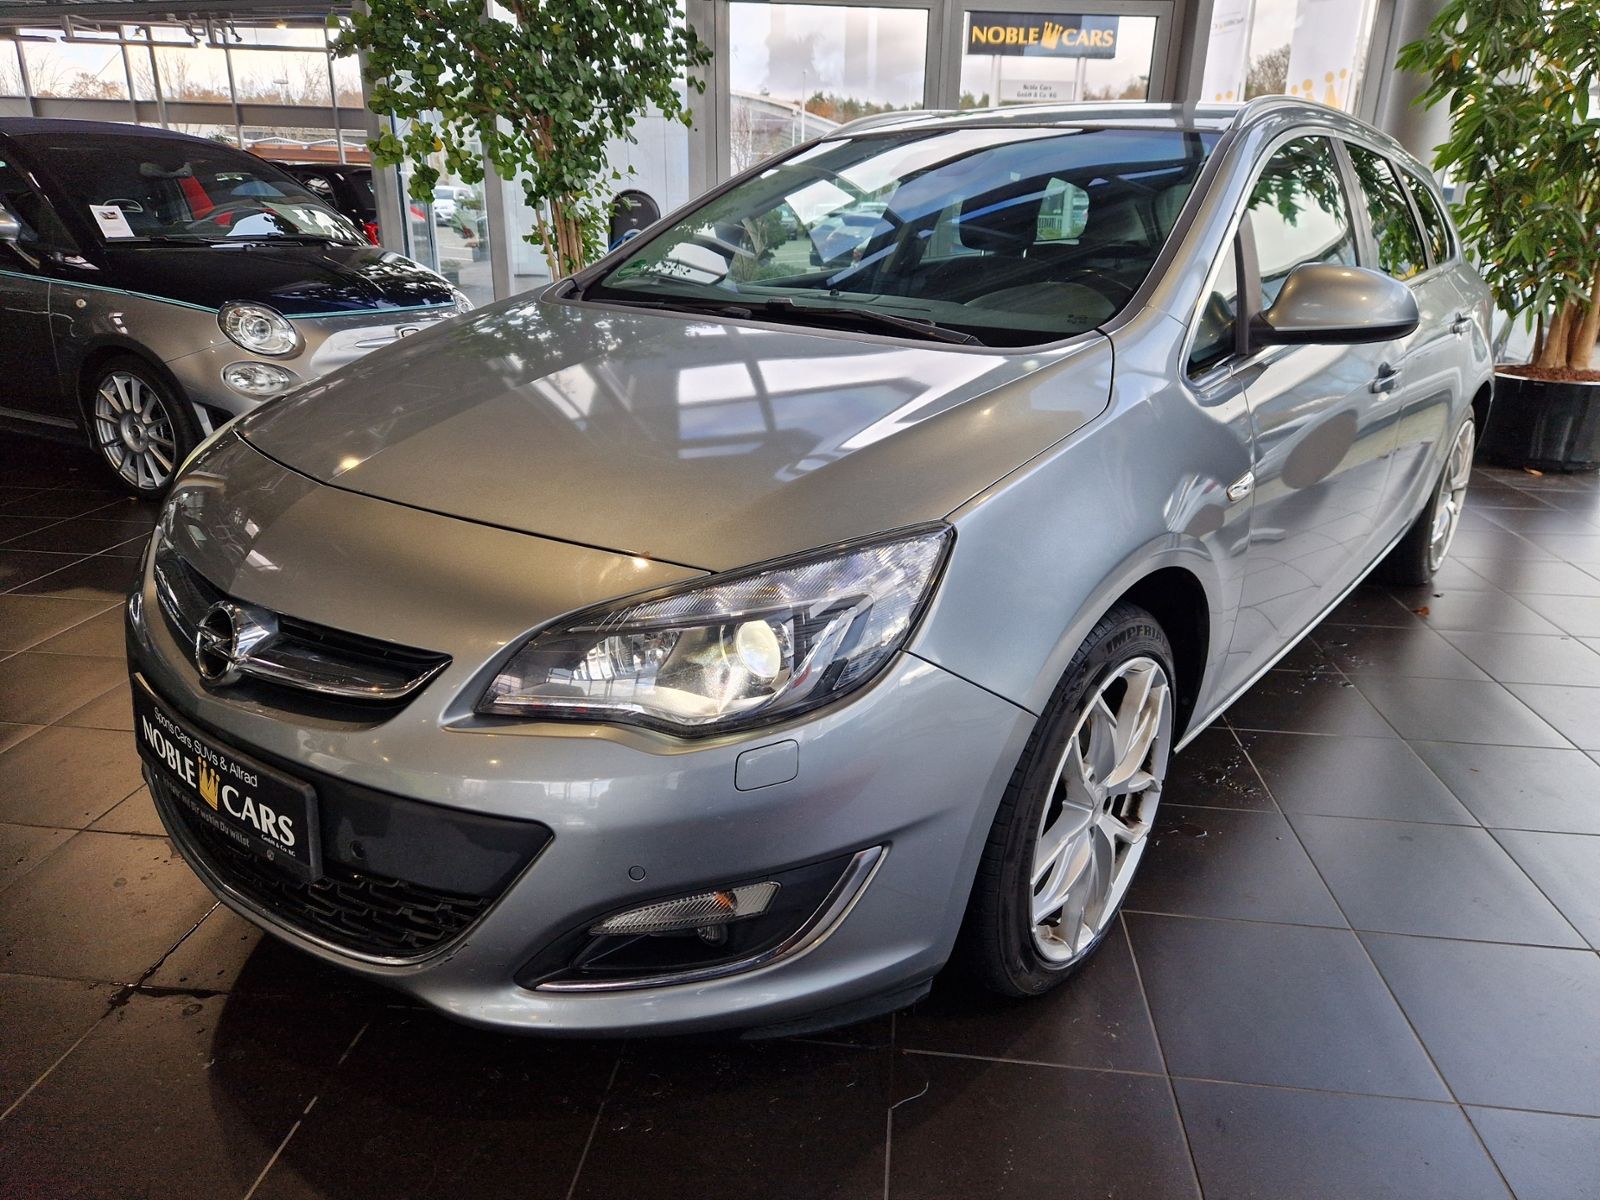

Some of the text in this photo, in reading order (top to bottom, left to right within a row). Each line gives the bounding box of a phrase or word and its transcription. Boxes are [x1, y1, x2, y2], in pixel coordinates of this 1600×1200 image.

[971, 25, 1114, 48] NOBLE CARS
[142, 714, 296, 847] NOBLE CARS
[219, 756, 228, 771] &
[229, 762, 258, 788] Allrad
